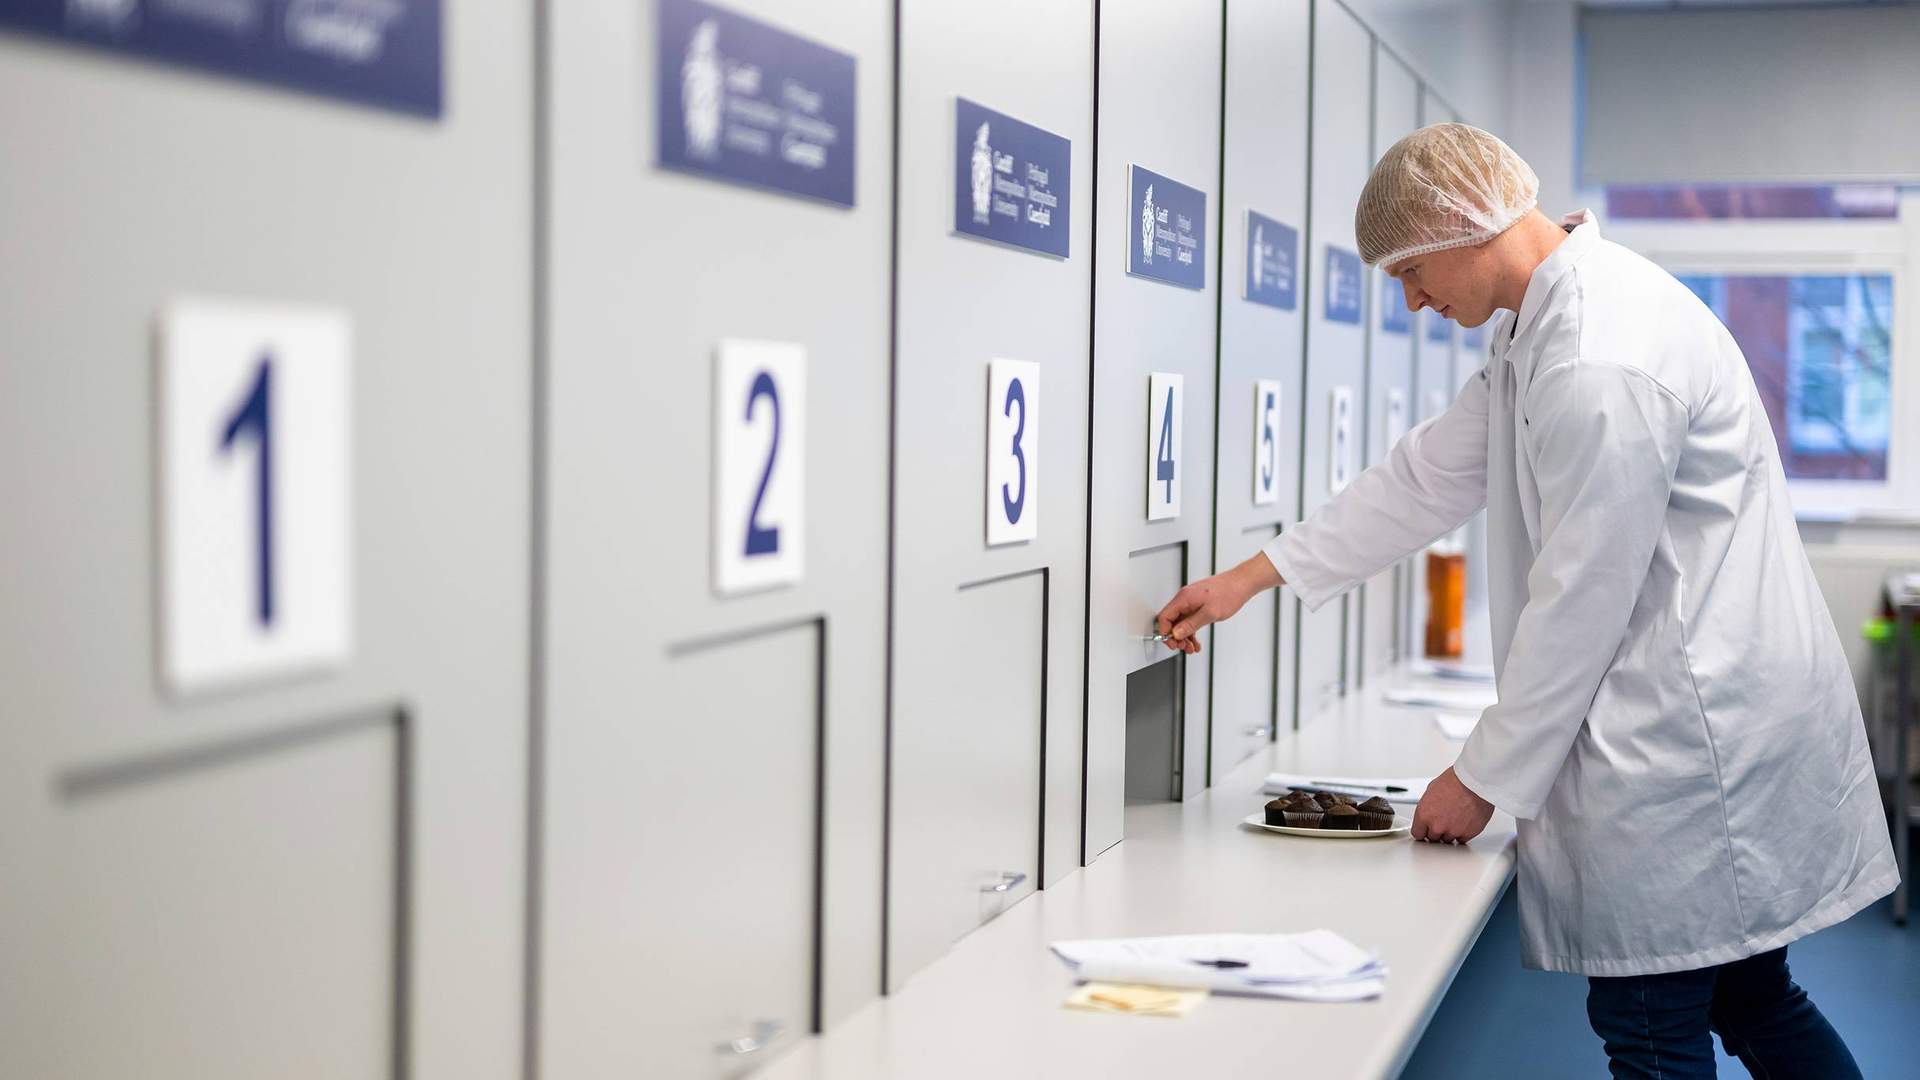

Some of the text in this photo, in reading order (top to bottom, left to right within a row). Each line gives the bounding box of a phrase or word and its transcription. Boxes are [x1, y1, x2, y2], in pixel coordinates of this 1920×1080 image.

[219, 352, 273, 628] 1
[743, 370, 782, 557] 2
[1002, 377, 1026, 525] 3
[1157, 386, 1175, 504] 4
[1262, 393, 1274, 492] 5
